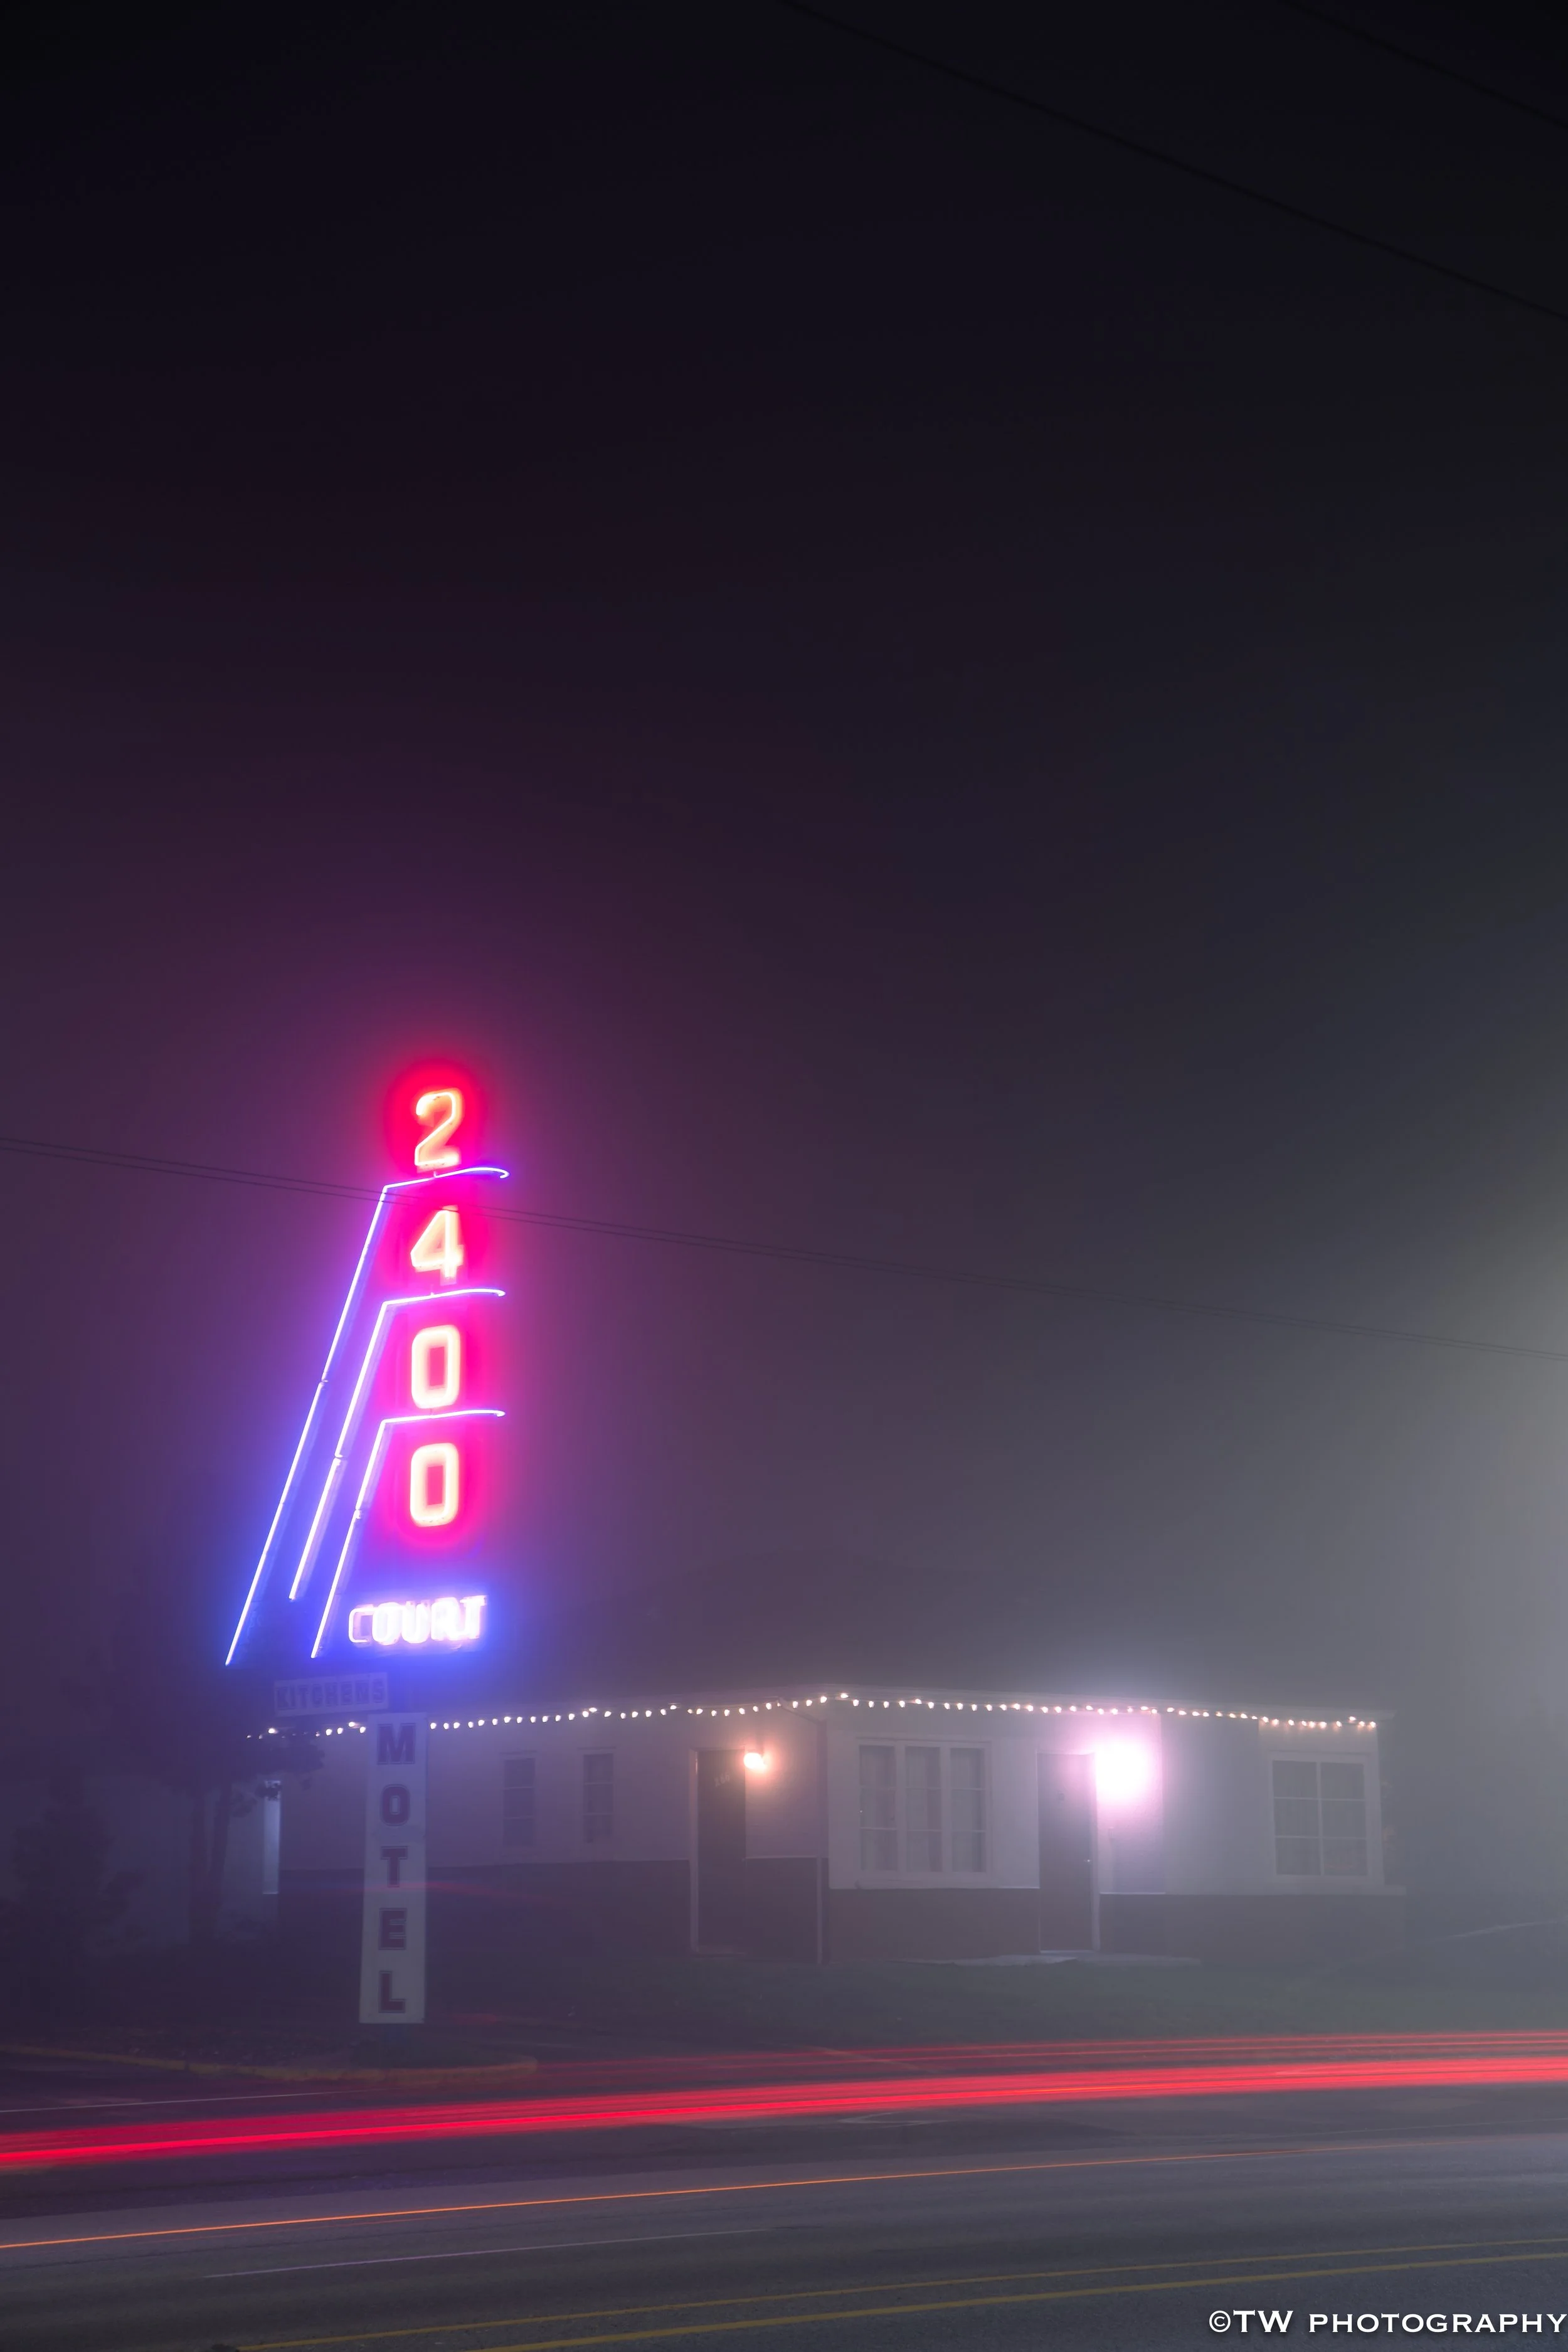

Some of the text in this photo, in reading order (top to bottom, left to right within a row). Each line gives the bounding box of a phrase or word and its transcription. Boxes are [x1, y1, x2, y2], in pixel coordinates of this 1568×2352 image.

[410, 1089, 464, 1527] 2400
[276, 1678, 386, 1711] KITCHENS
[349, 1595, 487, 1646] COURT
[378, 1724, 415, 2013] MOTEL
